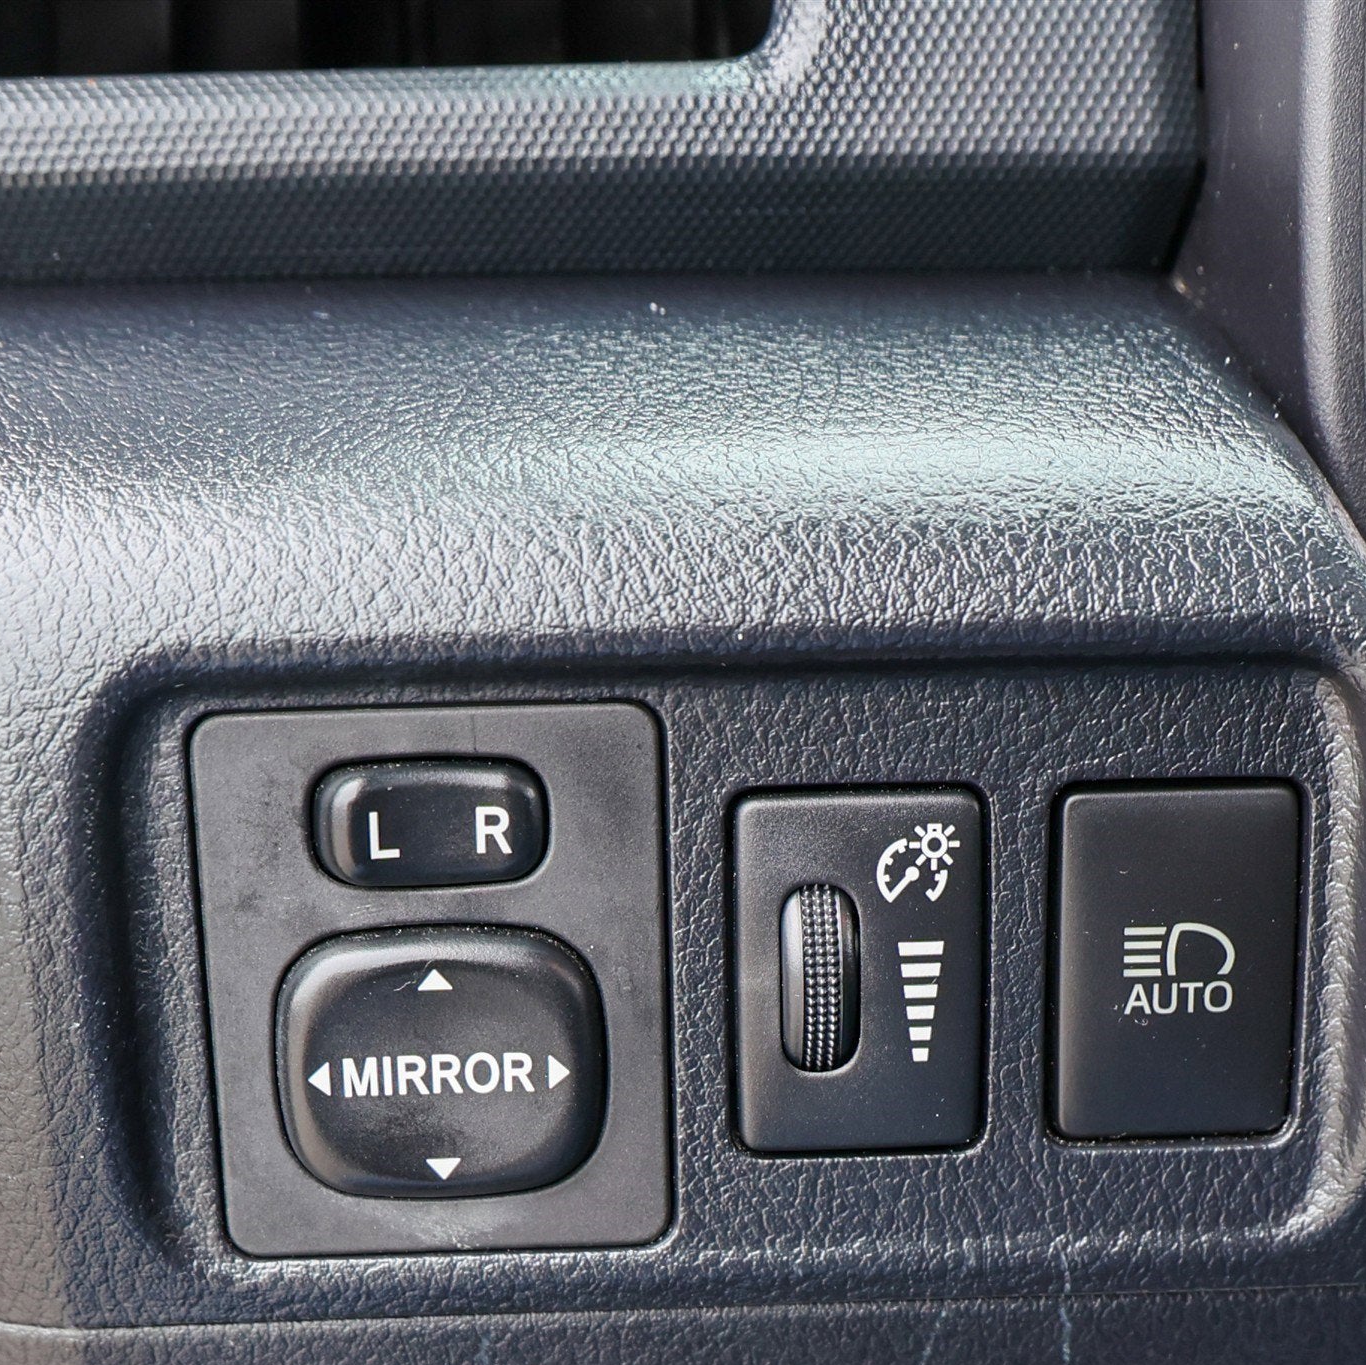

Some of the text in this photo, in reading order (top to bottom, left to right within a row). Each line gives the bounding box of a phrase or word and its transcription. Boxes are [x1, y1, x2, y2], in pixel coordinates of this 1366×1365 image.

[368, 805, 513, 860] L R
[1123, 980, 1234, 1016] AUTO
[341, 1051, 536, 1098] MIRROR
